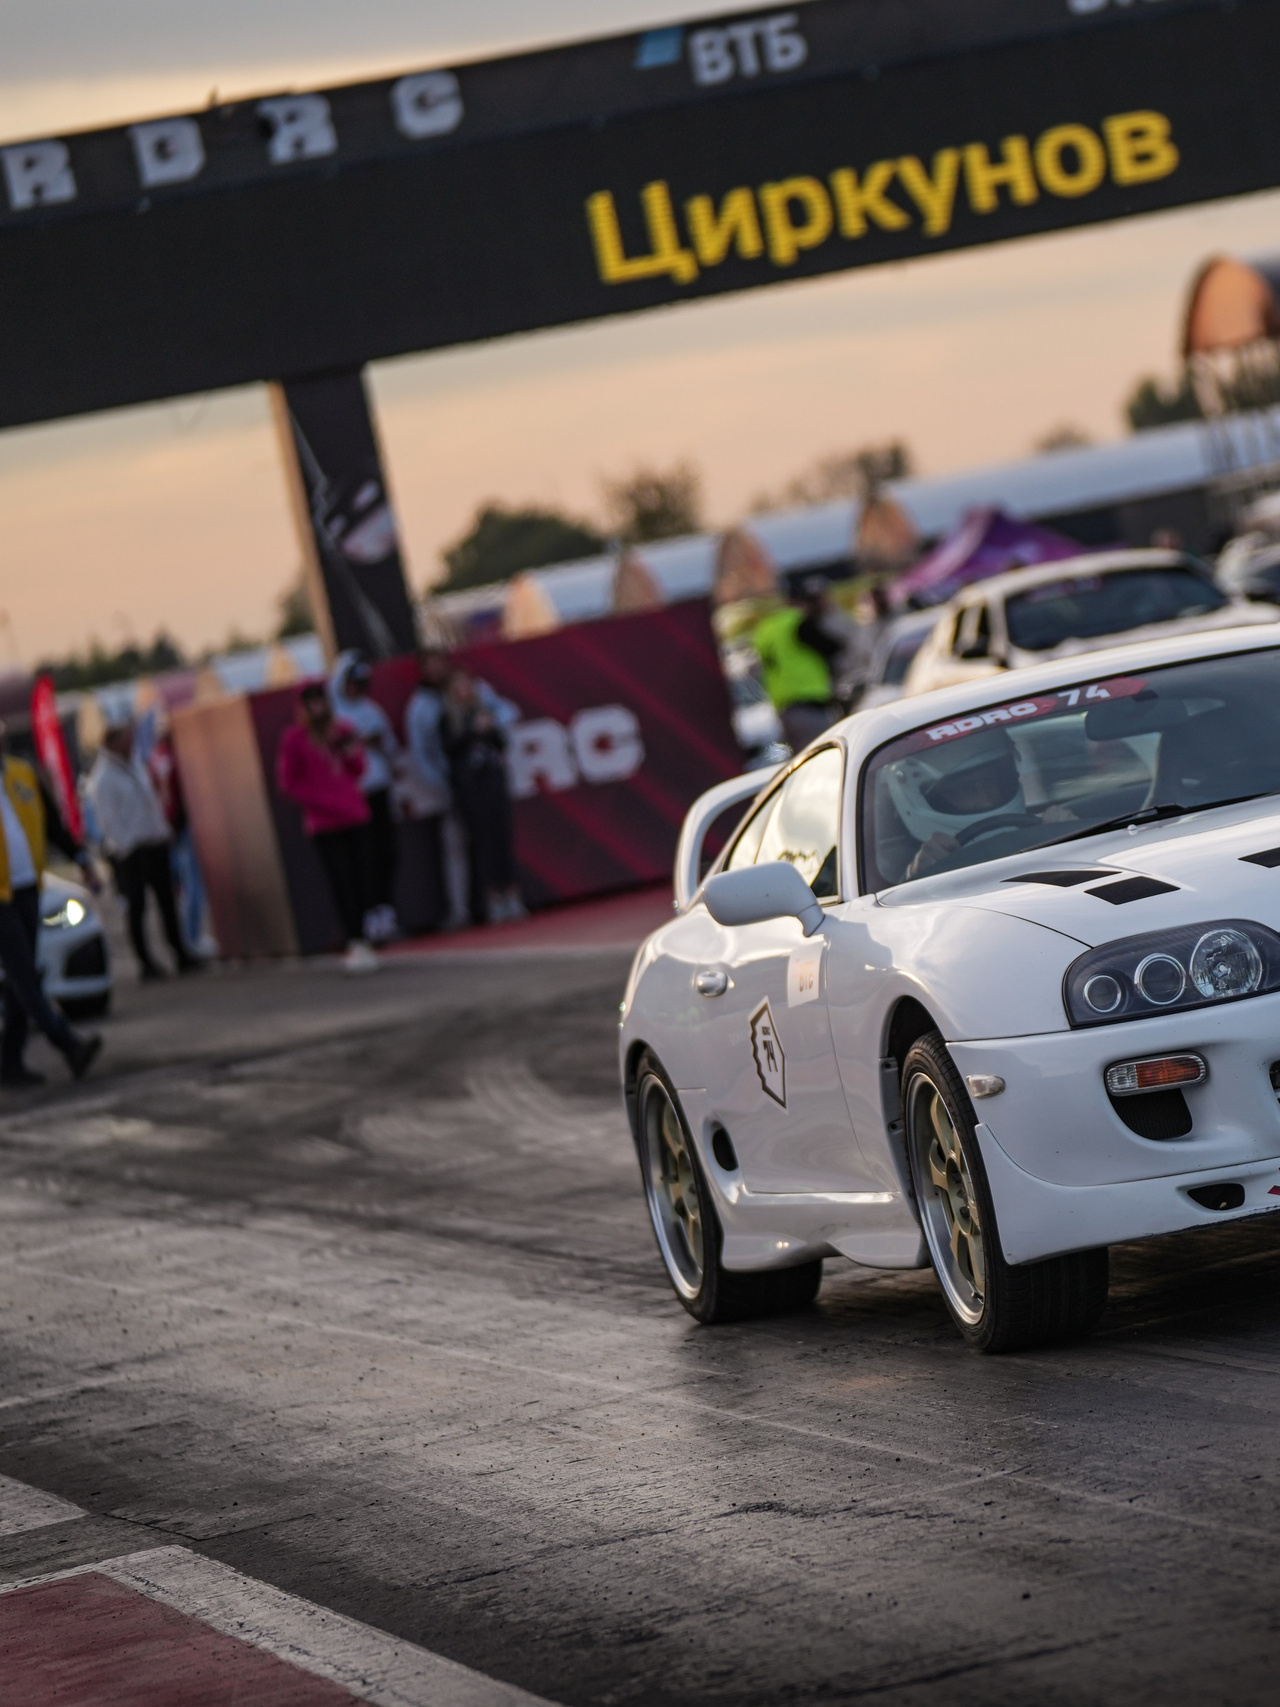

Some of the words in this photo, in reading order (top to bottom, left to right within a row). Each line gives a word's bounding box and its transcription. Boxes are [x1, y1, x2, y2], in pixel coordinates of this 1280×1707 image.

[690, 12, 807, 86] ВТБ
[587, 109, 1180, 284] Циркунов
[926, 702, 1038, 741] RDRC
[1057, 684, 1111, 706] 74
